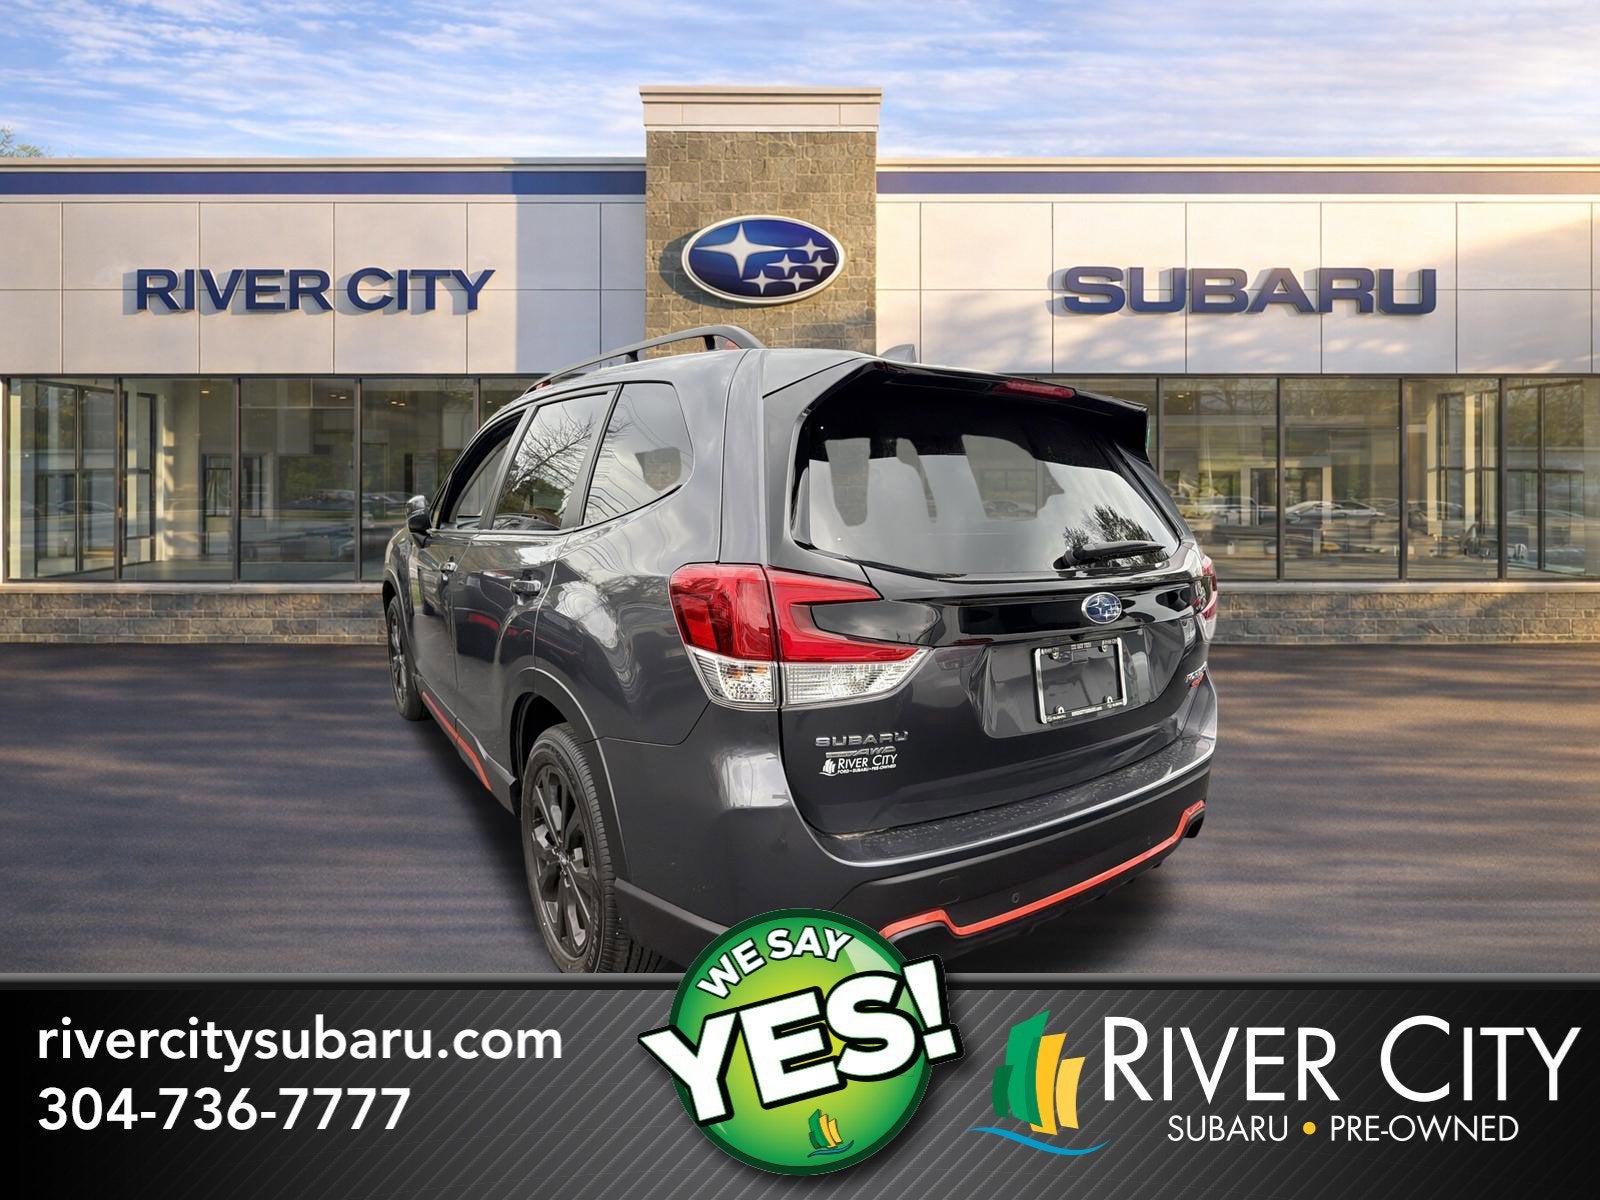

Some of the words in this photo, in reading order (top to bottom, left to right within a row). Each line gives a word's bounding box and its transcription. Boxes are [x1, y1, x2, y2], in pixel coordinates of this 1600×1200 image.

[135, 268, 335, 312] RIVER
[346, 266, 496, 312] CITY
[1063, 265, 1437, 314] SUBARU
[815, 731, 909, 748] SUBARU
[838, 757, 869, 770] RIVER
[872, 753, 898, 766] CITY
